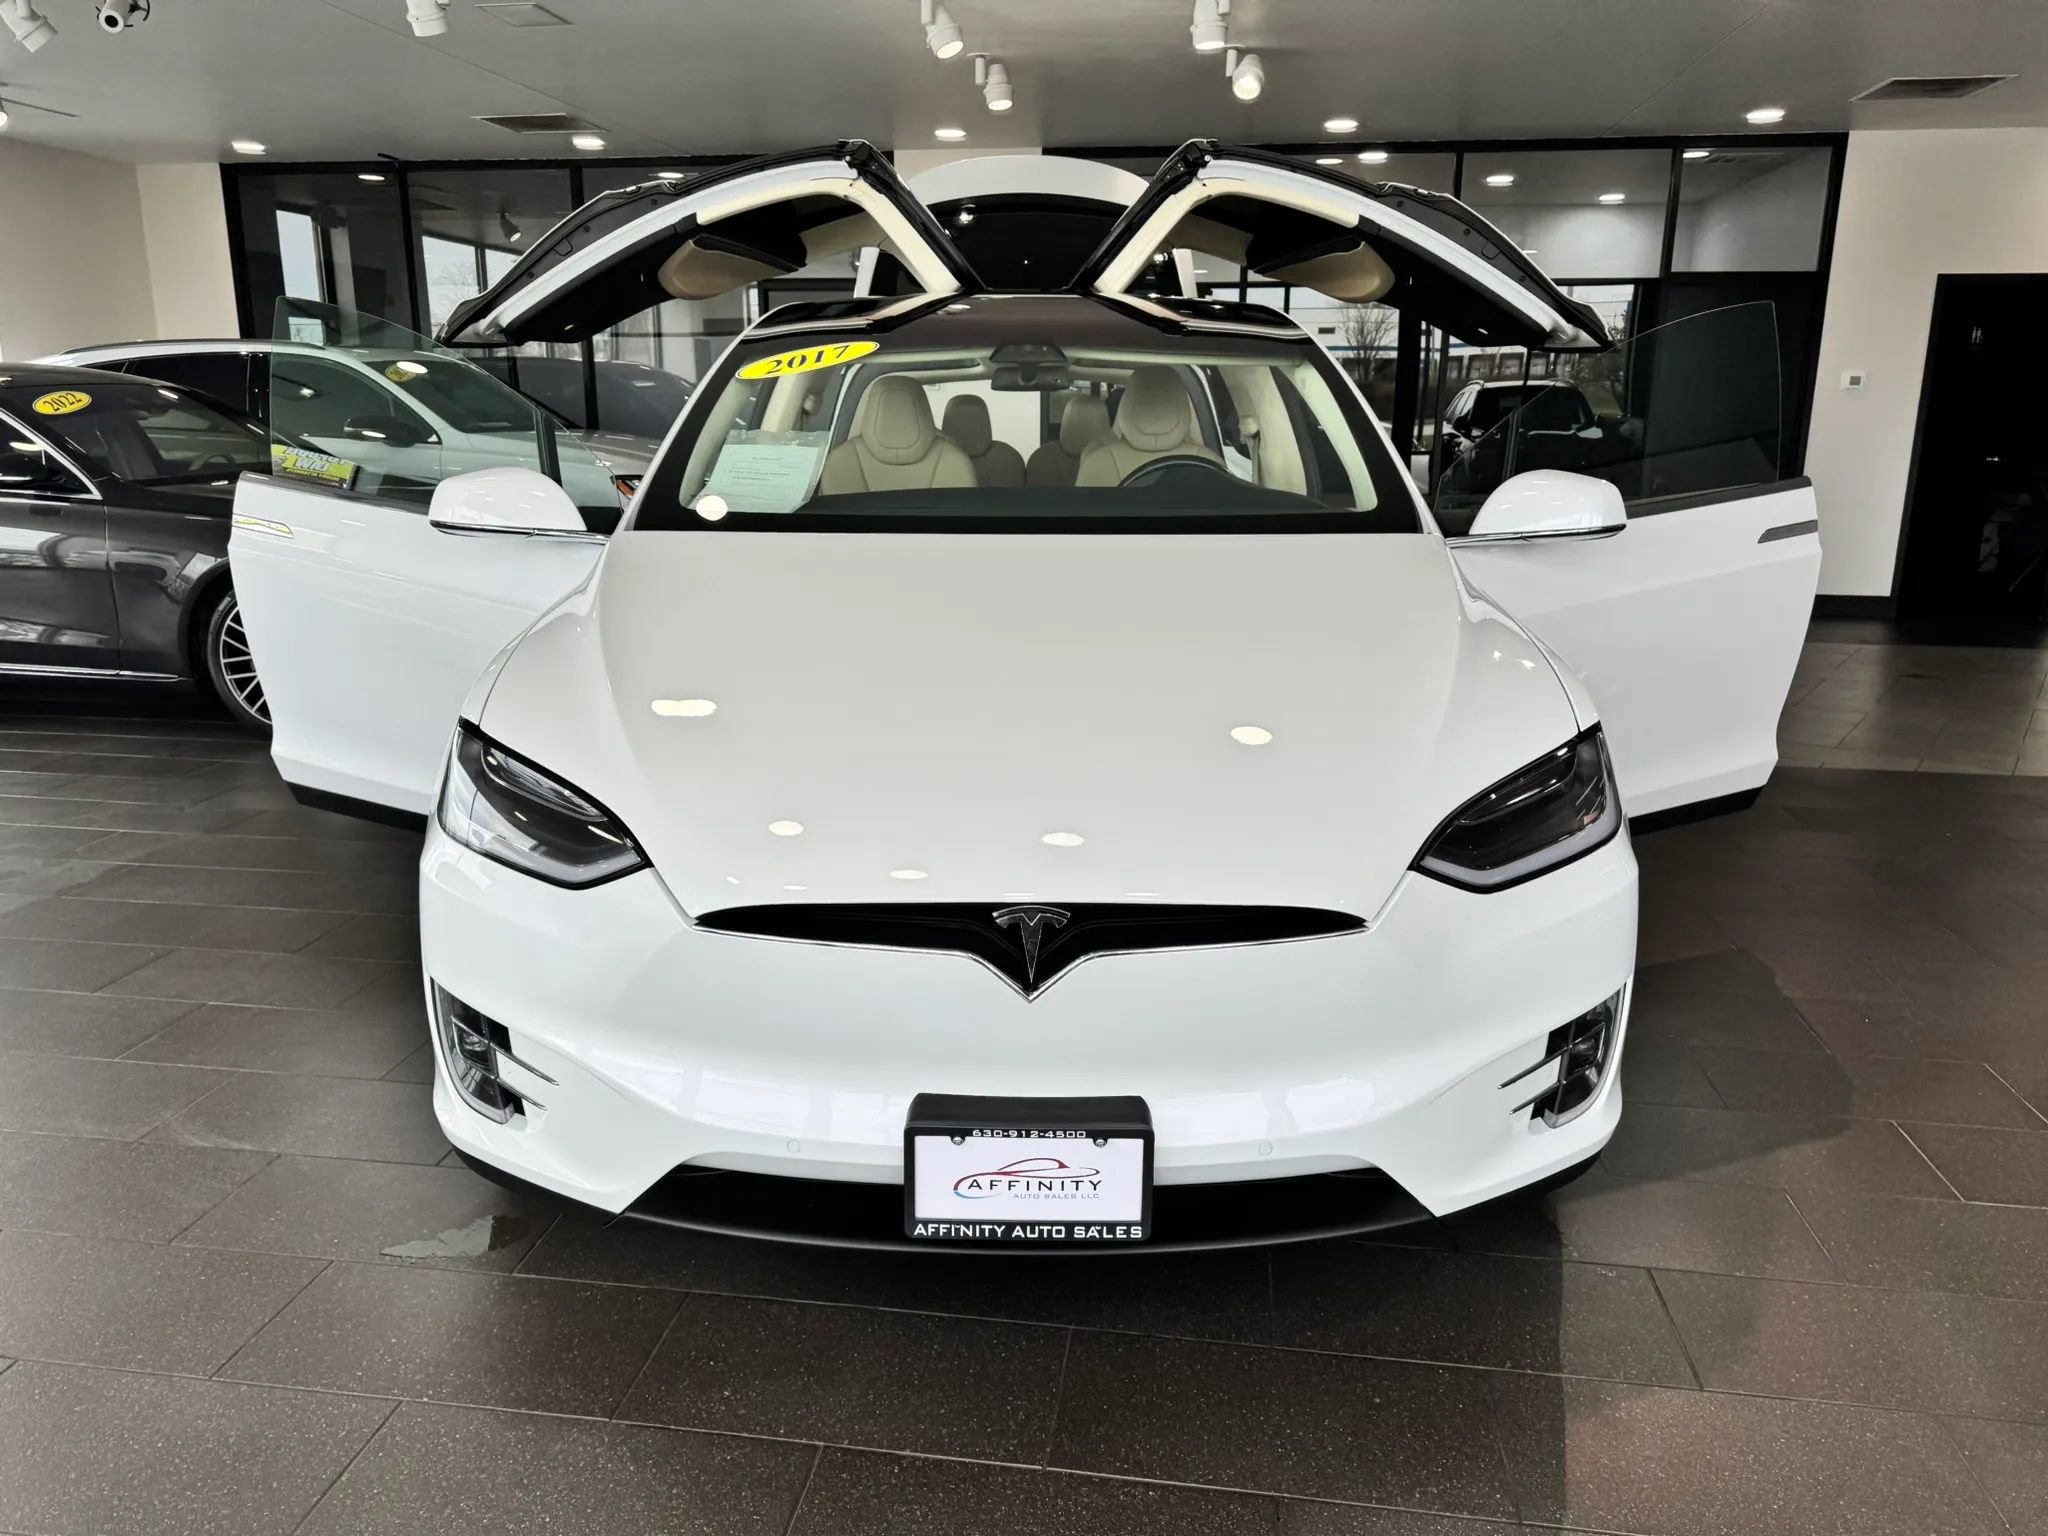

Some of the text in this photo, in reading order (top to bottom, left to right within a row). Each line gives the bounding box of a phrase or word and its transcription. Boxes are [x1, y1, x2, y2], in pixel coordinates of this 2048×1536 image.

[764, 344, 850, 375] 2017
[42, 392, 82, 412] 2022
[972, 1129, 1087, 1139] 630-912-4500
[967, 1178, 1102, 1192] AFFINITY
[914, 1223, 1142, 1239] AFFINITY AUTO SALES
